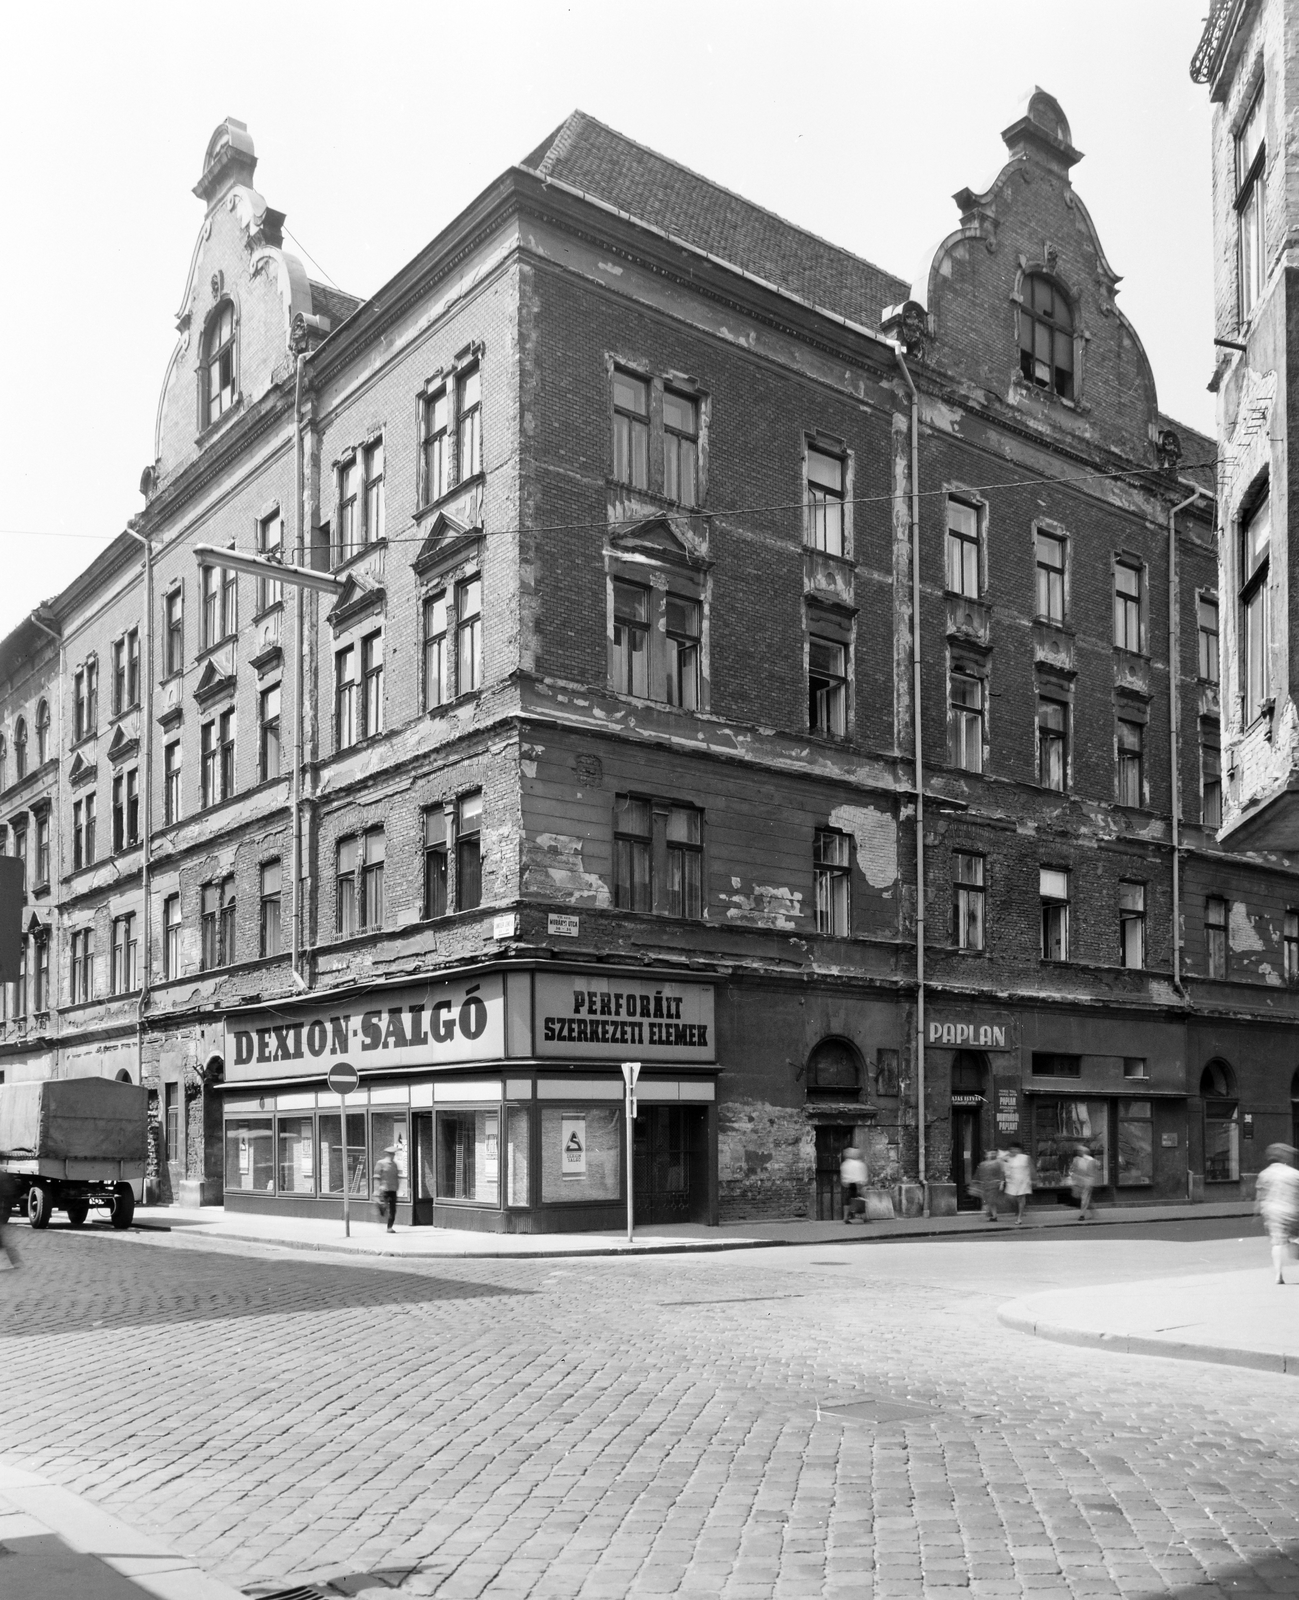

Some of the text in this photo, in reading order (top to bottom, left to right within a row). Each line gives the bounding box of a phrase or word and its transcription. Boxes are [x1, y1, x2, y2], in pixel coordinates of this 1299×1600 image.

[573, 990, 682, 1020] PERFORÁLT
[544, 1017, 708, 1046] SZERKEZETI ELEMEK
[930, 1022, 1005, 1046] PAPLAN
